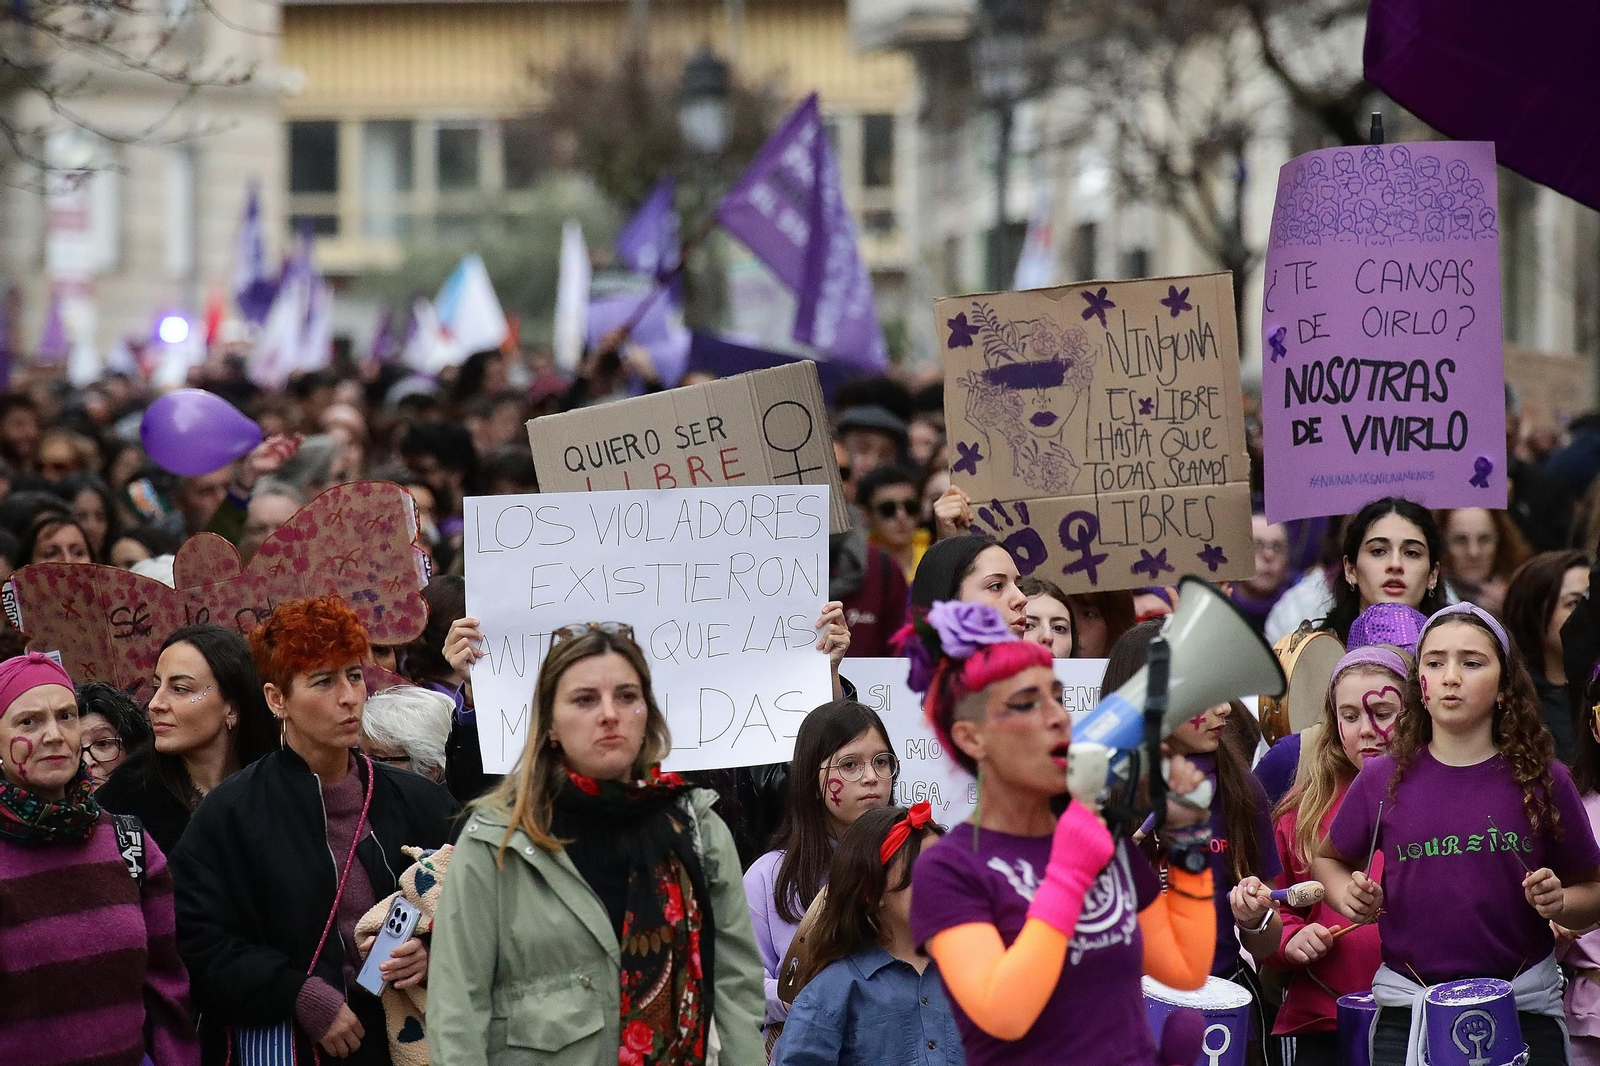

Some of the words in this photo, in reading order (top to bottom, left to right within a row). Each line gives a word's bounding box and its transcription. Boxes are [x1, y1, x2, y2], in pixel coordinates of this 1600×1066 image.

[1265, 261, 1318, 313] ¿TE
[1355, 258, 1475, 297] CANSAS
[1298, 312, 1330, 344] DE
[1361, 304, 1476, 342] OIRLO?
[1105, 387, 1143, 425] ES
[1150, 386, 1221, 424] LIBRE
[1284, 356, 1456, 409] NOSOTRAS
[563, 429, 661, 473] QUIERO
[674, 416, 727, 450] SER
[1094, 421, 1152, 461] HASTA
[1292, 417, 1322, 447] DE
[1341, 410, 1468, 457] VIVIRLO
[1083, 461, 1156, 493] TODAS
[476, 504, 576, 554] LOS
[589, 493, 822, 547] VIOLADORES
[1096, 494, 1216, 547] LIBRES
[530, 552, 819, 610] EXISTIERON
[650, 619, 730, 665] QUE
[741, 614, 818, 654] LAS
[868, 684, 891, 711] SI
